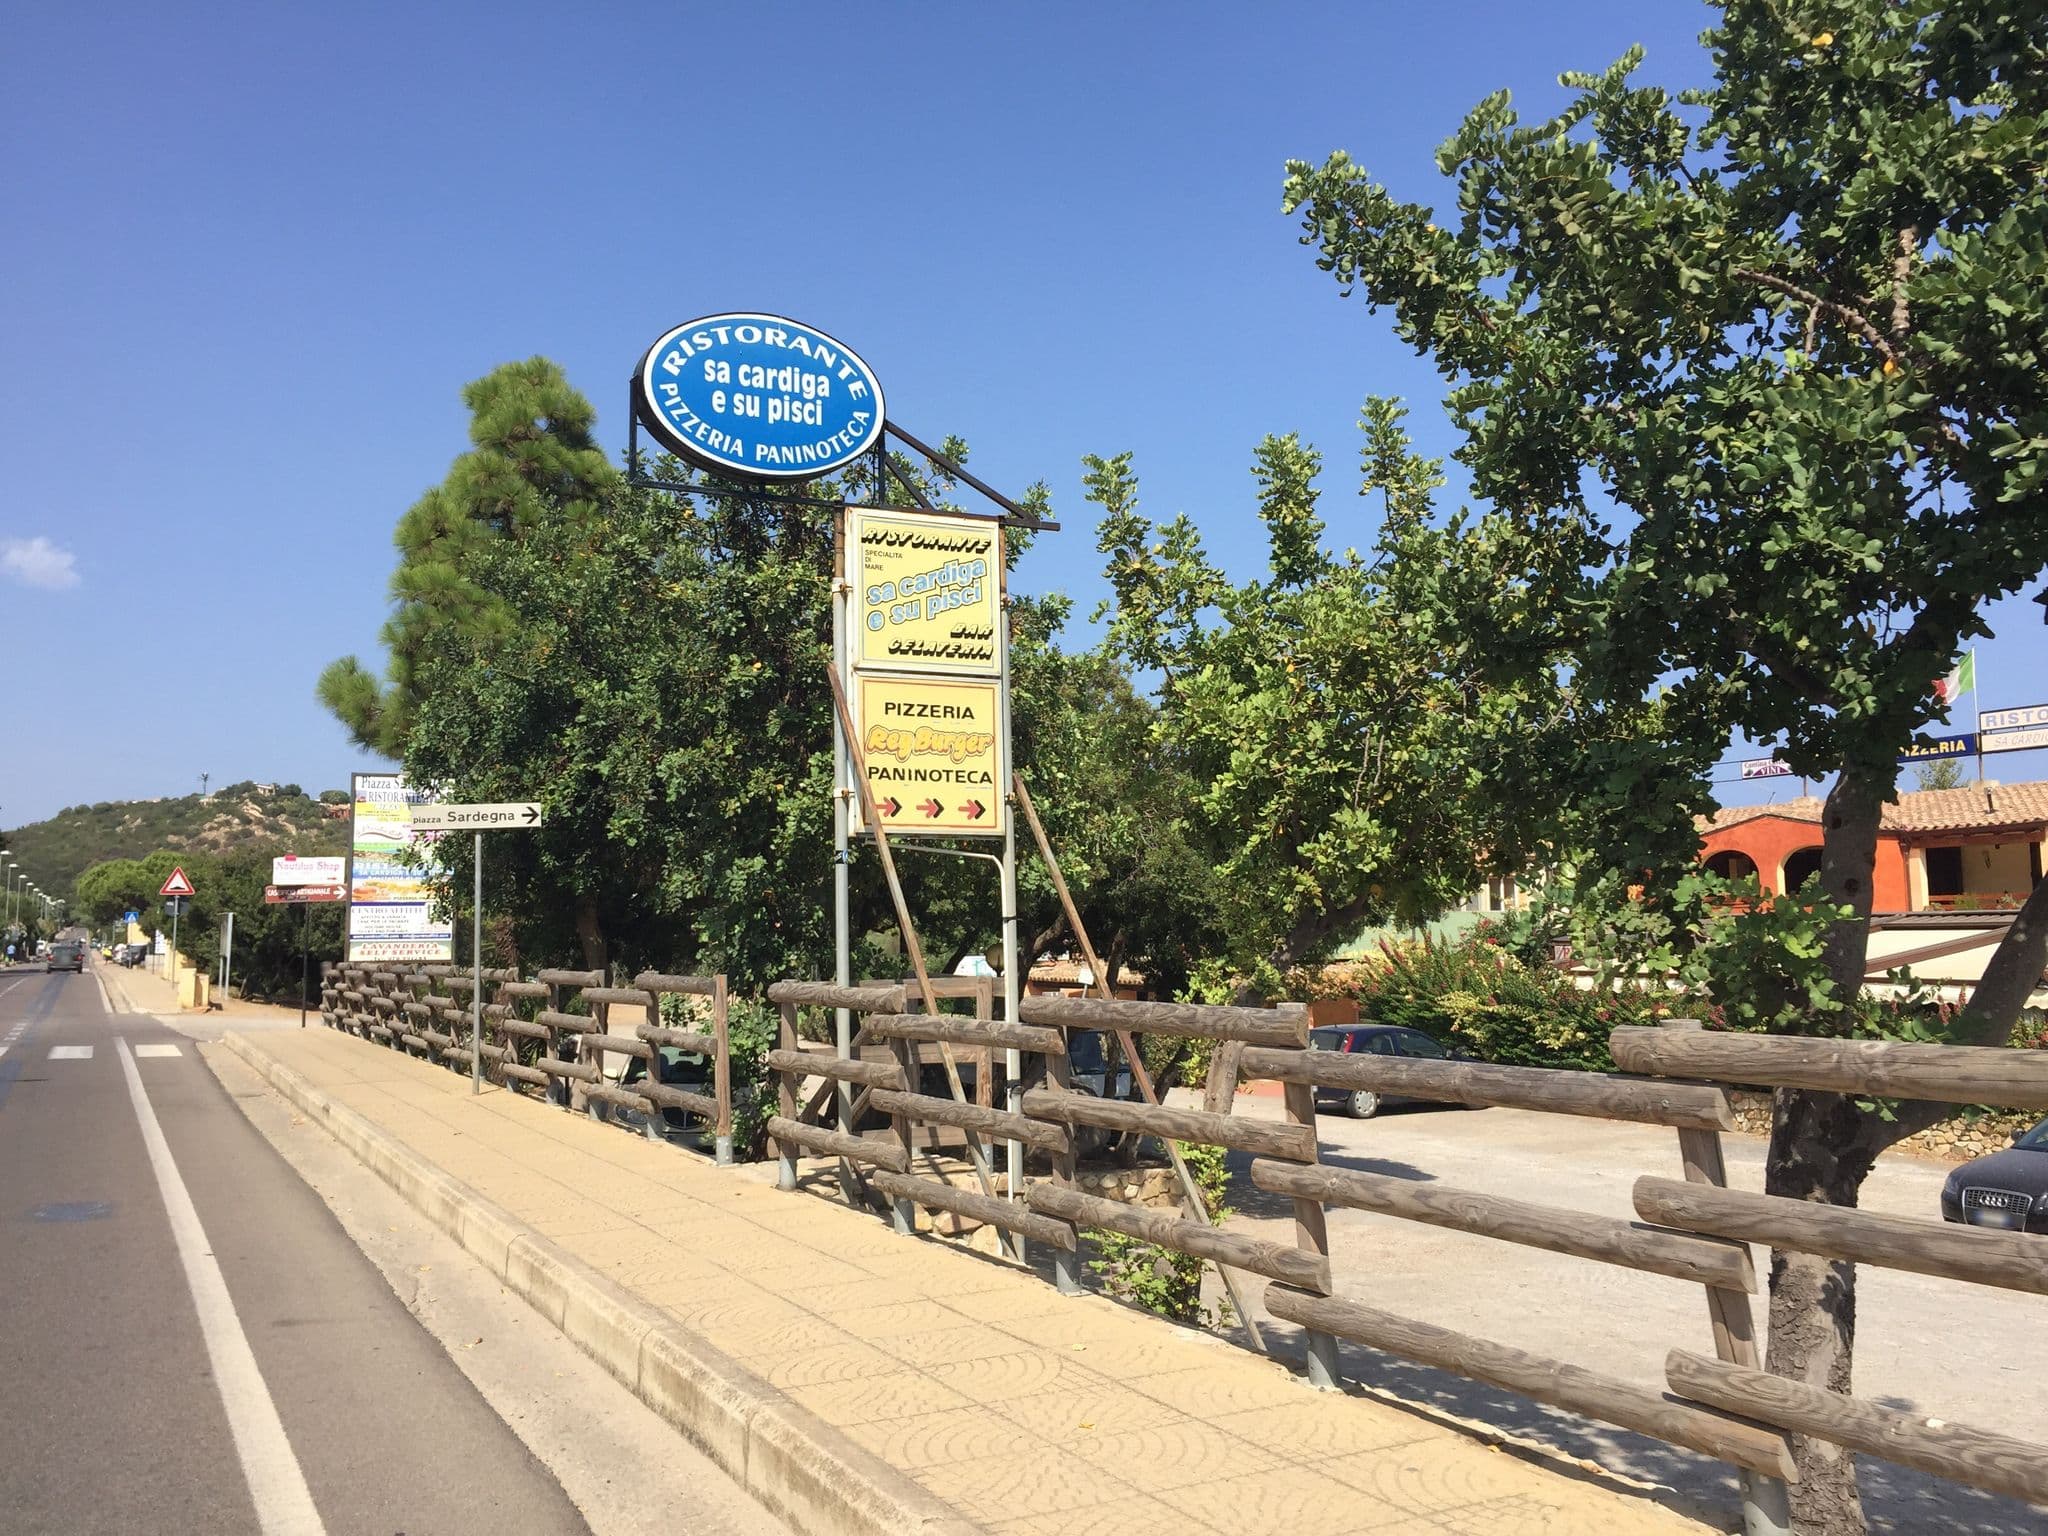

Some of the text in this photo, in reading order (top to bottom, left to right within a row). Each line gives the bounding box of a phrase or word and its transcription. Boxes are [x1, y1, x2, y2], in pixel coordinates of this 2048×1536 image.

[661, 325, 868, 400] RISTORANTE
[704, 359, 830, 398] sa cardiga
[711, 390, 823, 426] e su pisci
[659, 382, 870, 464] PIZZERIA PANINOTECA
[861, 528, 992, 554] RISTORANTE
[866, 558, 987, 606] sa cardiga
[867, 578, 982, 631] e su pisci
[950, 623, 993, 640] BAR
[888, 640, 993, 660] GELATERIA
[884, 702, 975, 720] PIZZERIA
[913, 726, 994, 764] Burger
[361, 776, 391, 789] Piazza
[868, 766, 993, 784] PANINOTECA
[447, 811, 515, 823] Sardegna
[317, 861, 340, 872] Shop
